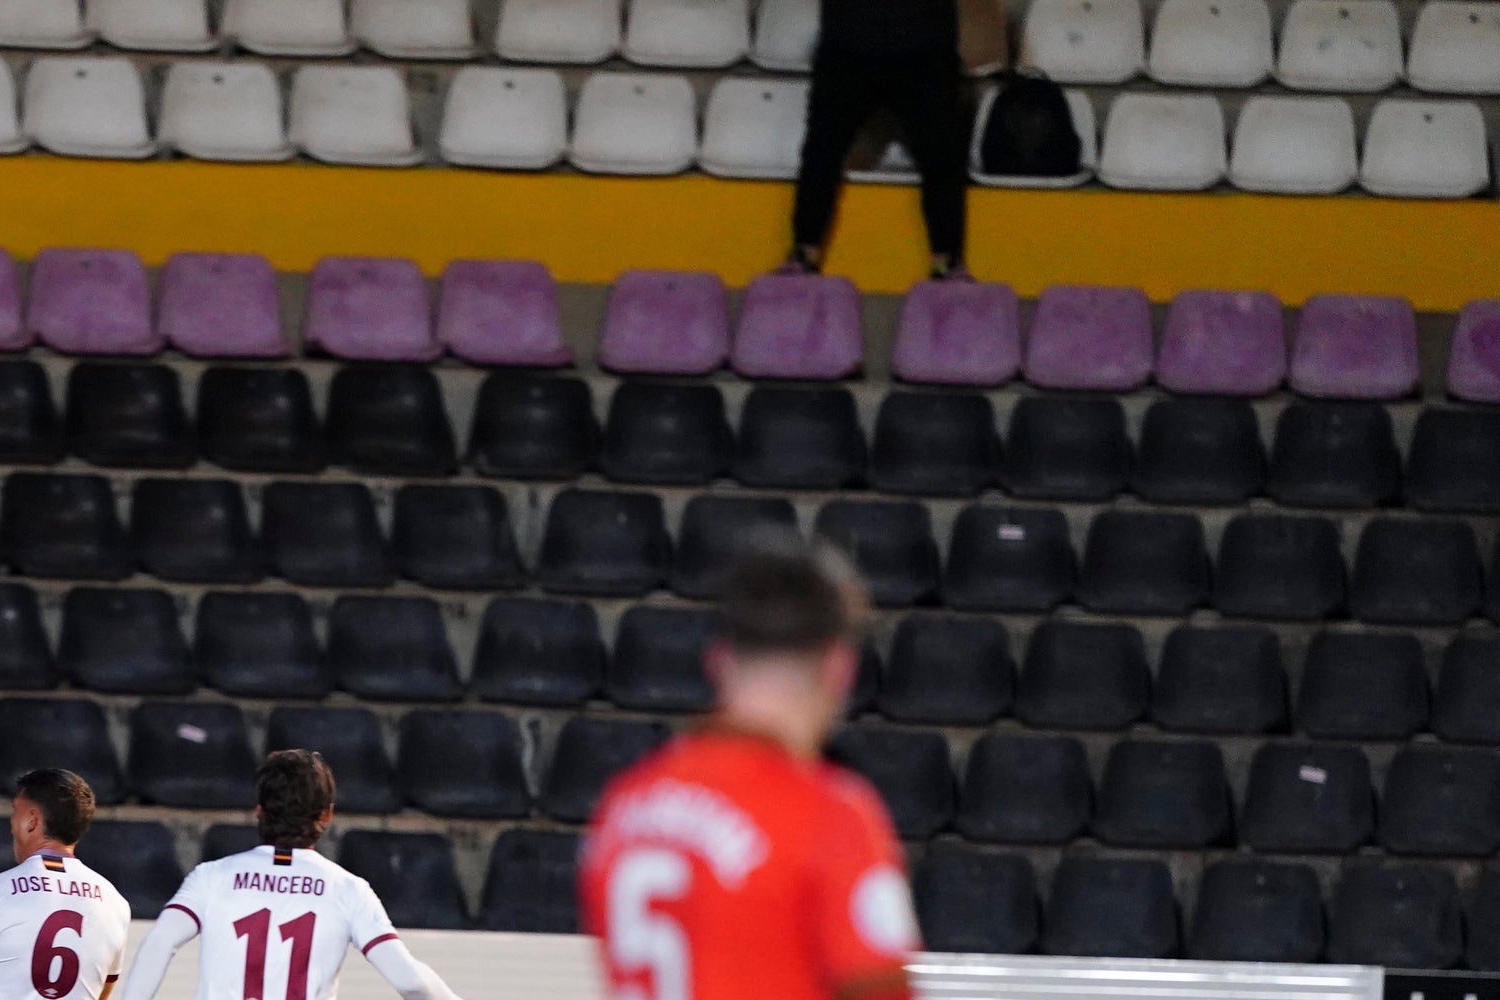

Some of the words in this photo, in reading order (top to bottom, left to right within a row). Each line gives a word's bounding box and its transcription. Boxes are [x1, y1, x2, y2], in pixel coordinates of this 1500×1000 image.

[11, 876, 53, 896] JOSE
[57, 878, 104, 902] LARA
[232, 871, 326, 897] MANCEBO
[30, 908, 84, 1000] 6
